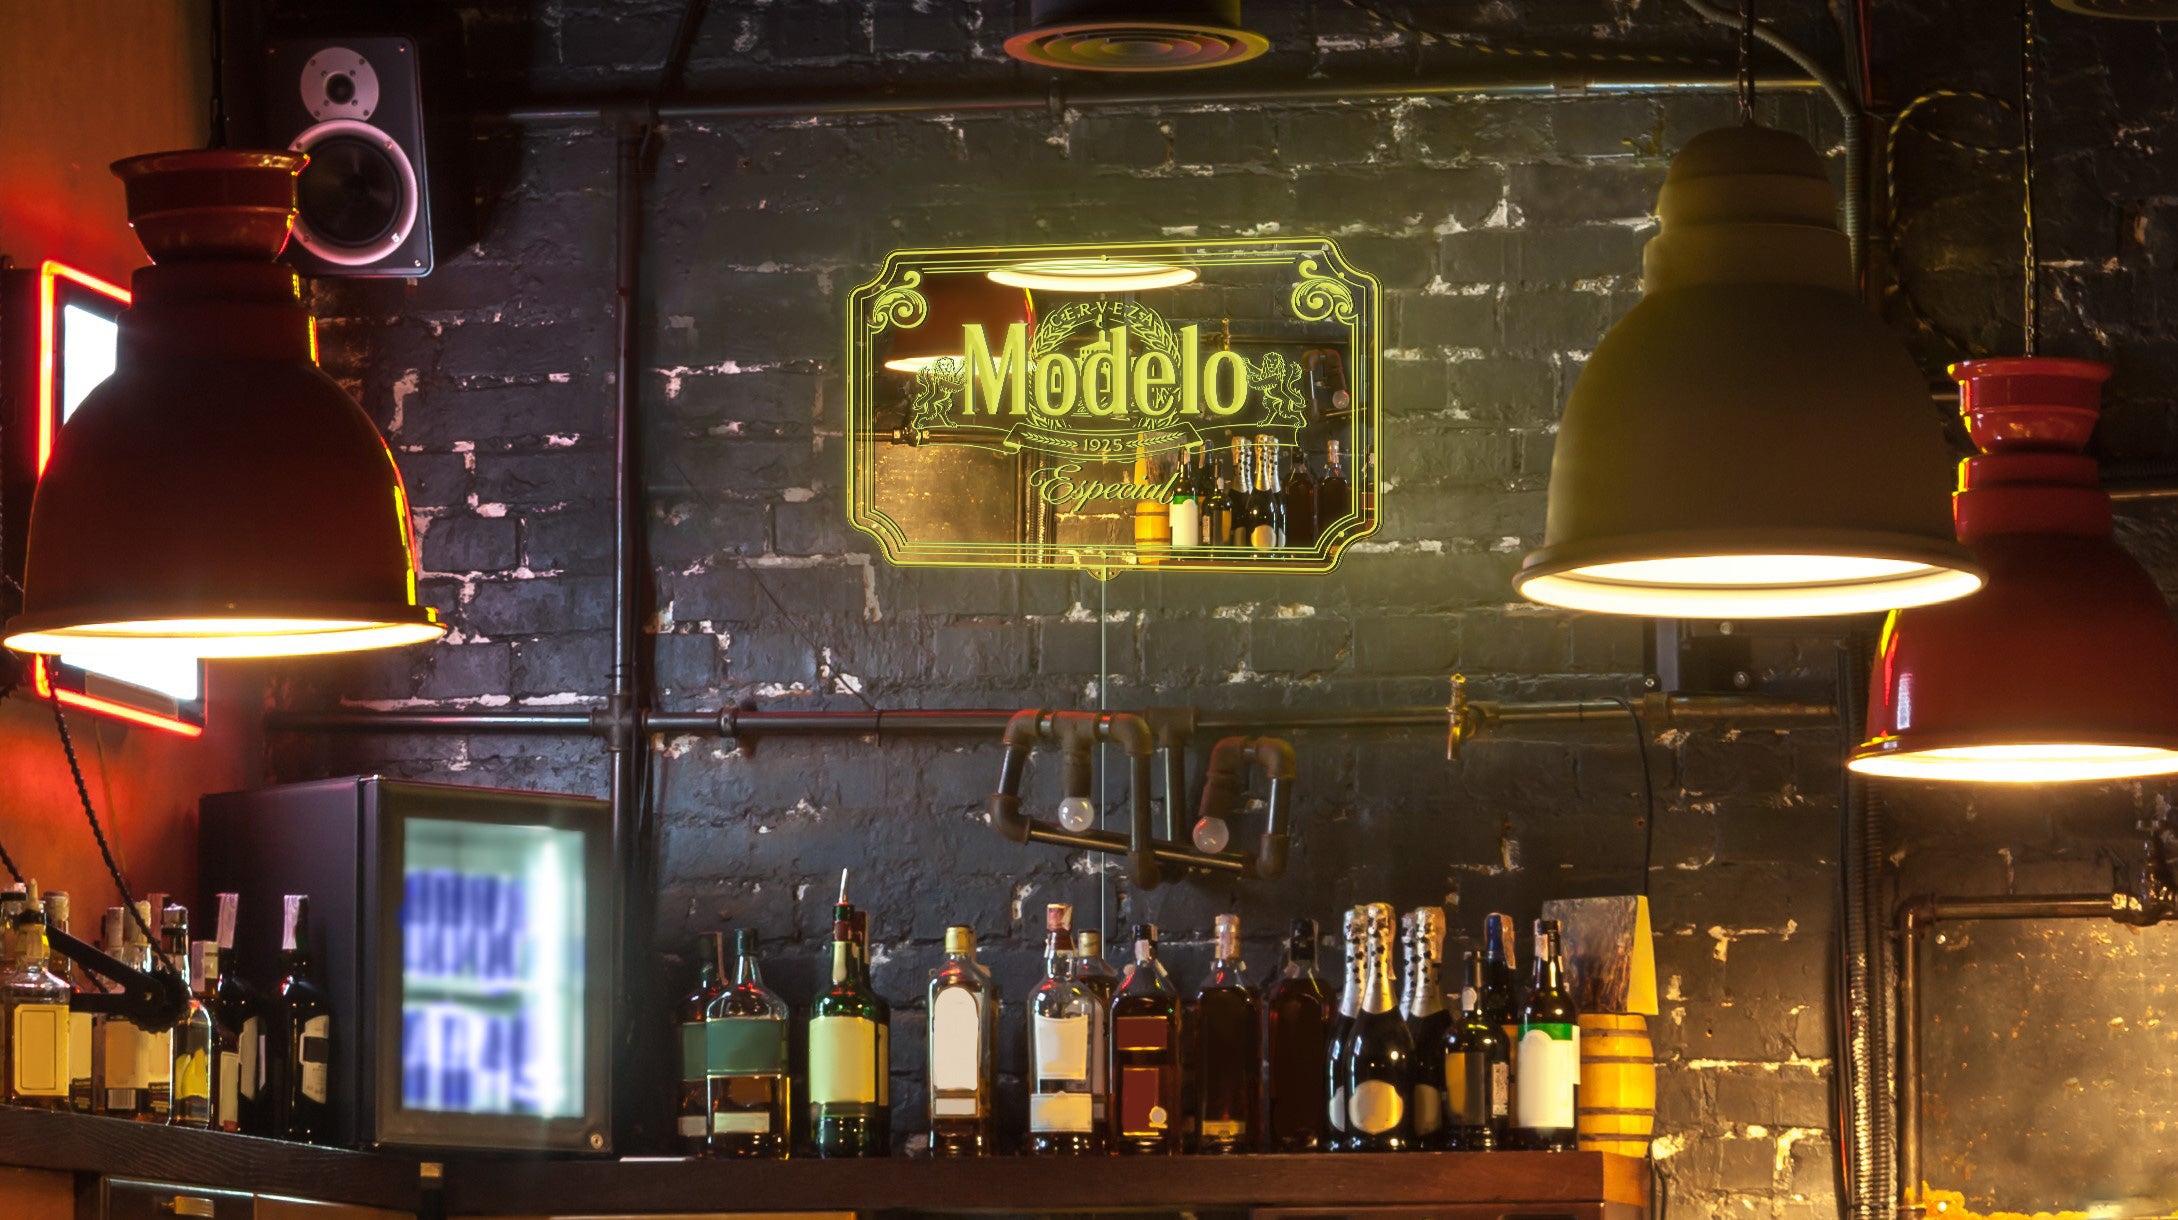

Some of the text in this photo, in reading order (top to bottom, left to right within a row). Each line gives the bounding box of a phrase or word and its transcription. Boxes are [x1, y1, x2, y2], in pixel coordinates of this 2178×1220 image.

[1050, 301, 1155, 327] CERVEZA
[962, 322, 1248, 417] Modelo
[1083, 438, 1124, 452] 1925
[1029, 463, 1182, 512] Especial
